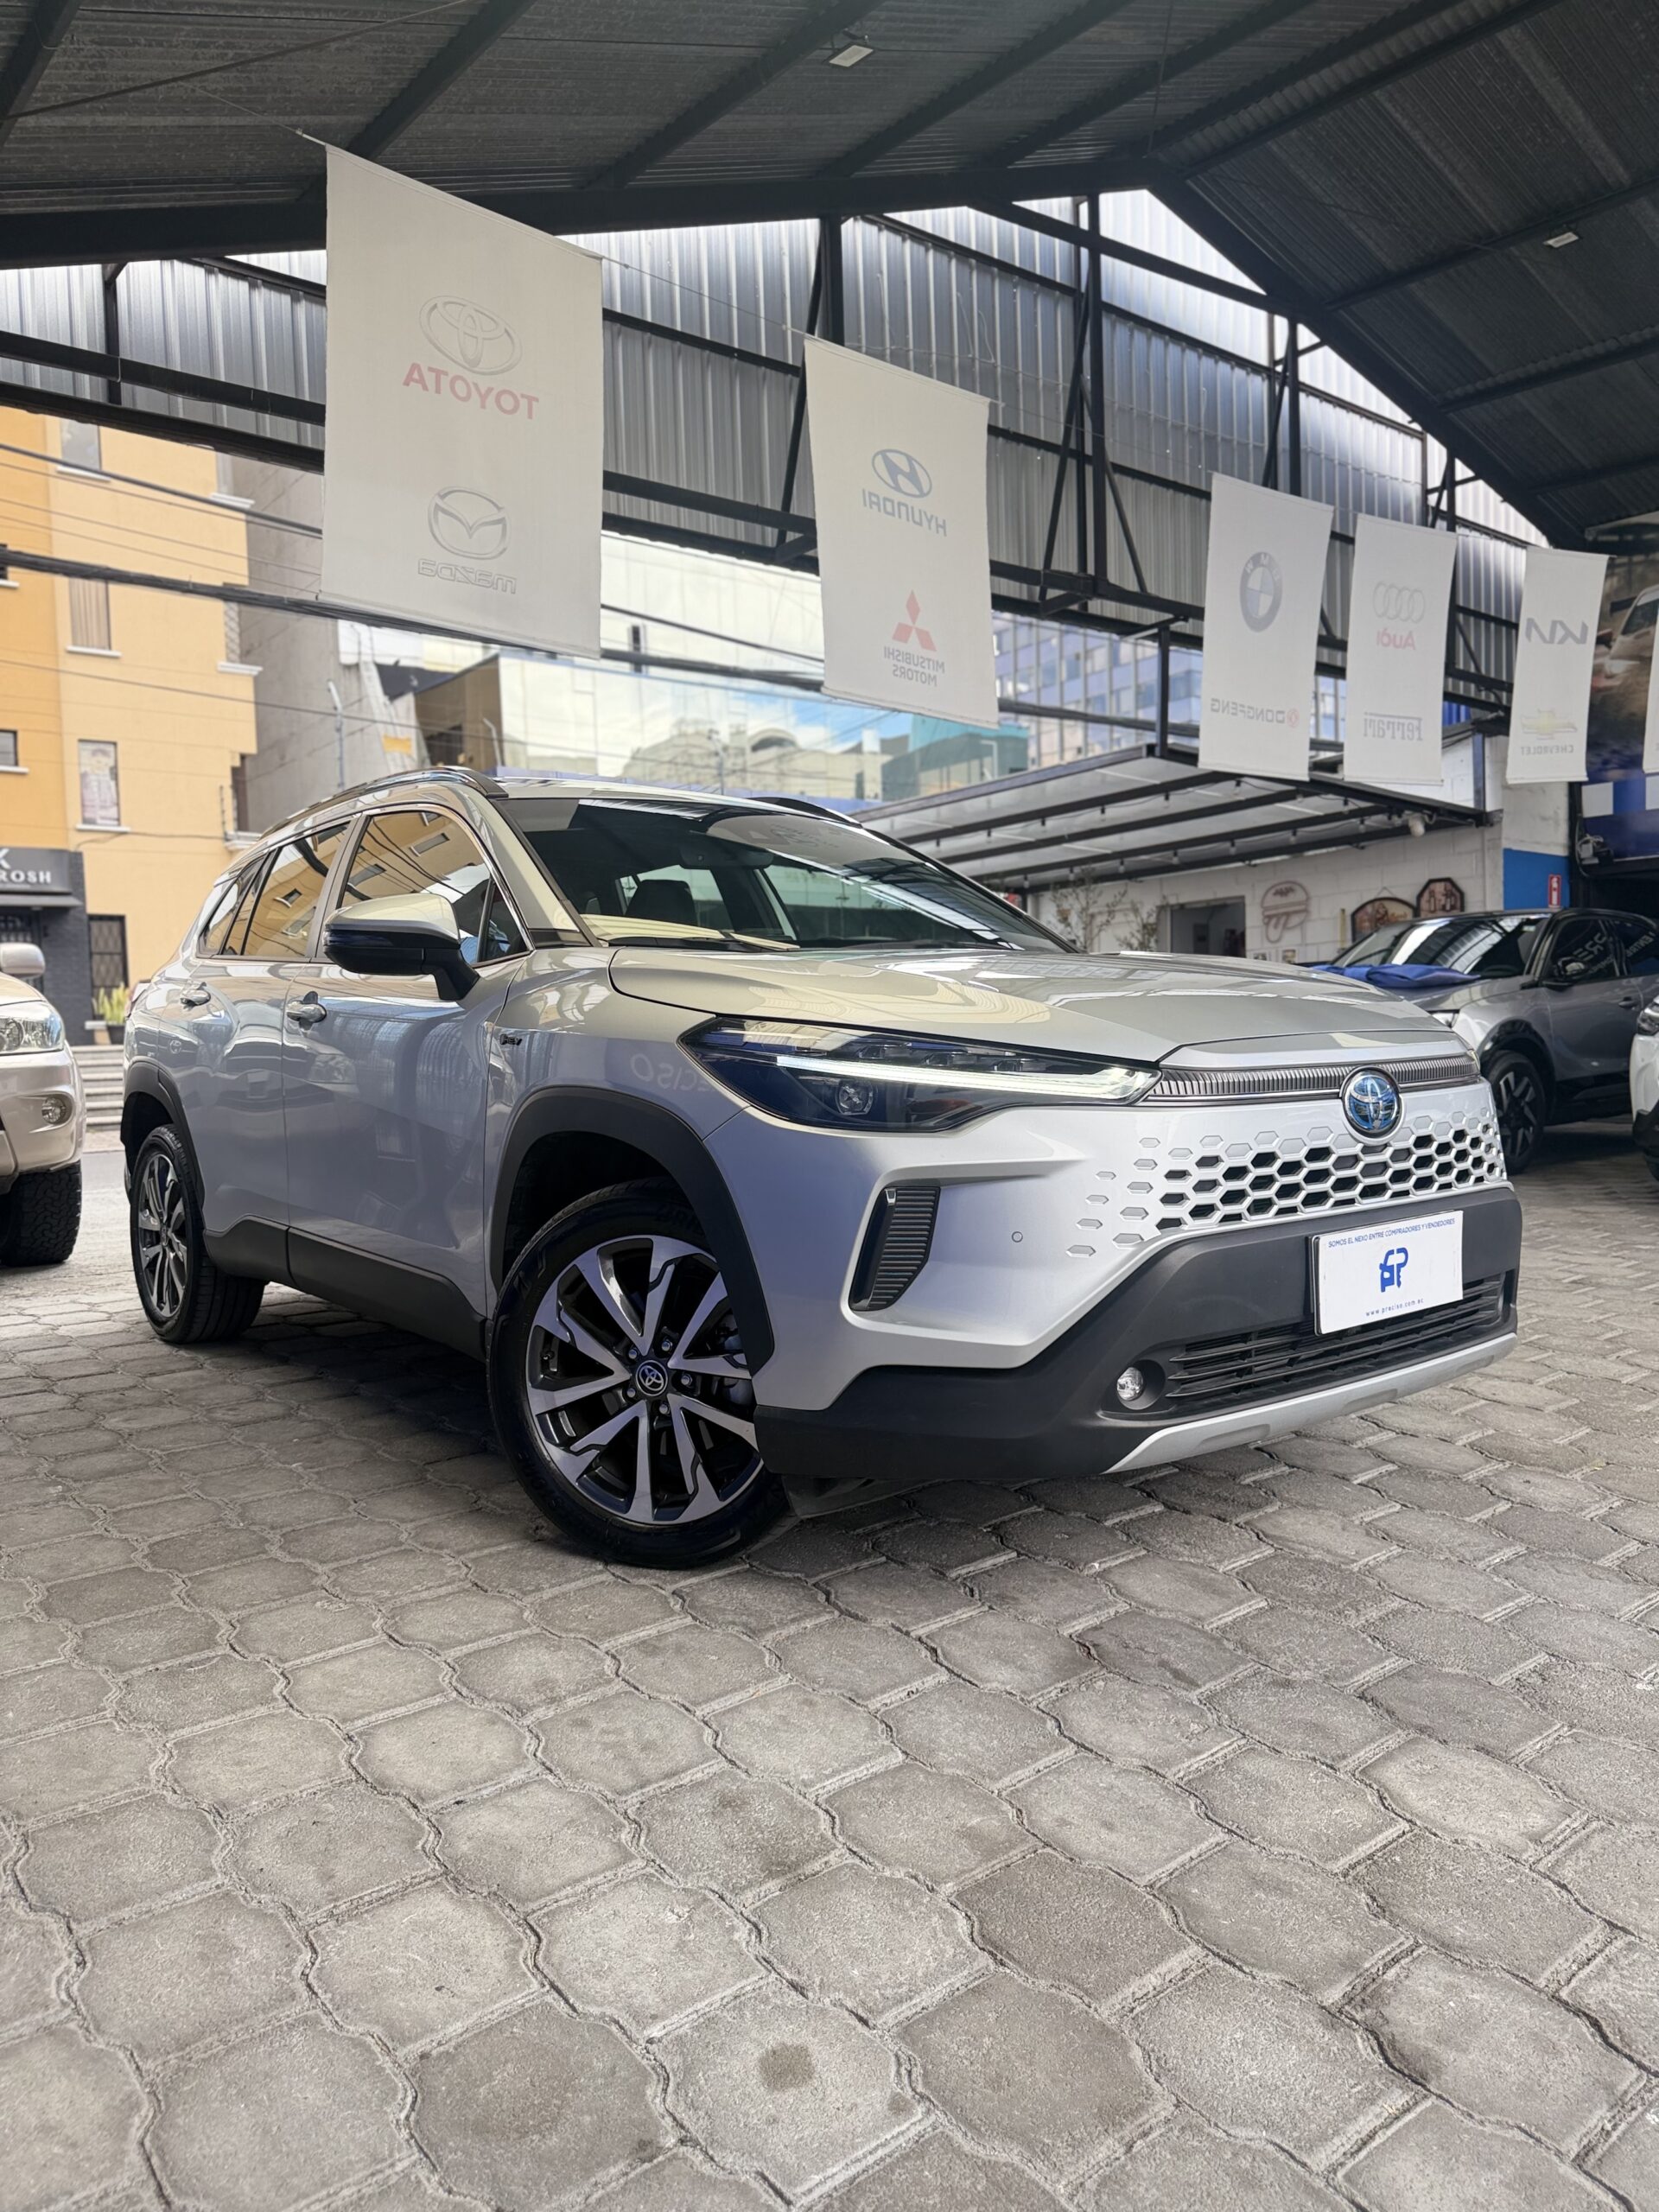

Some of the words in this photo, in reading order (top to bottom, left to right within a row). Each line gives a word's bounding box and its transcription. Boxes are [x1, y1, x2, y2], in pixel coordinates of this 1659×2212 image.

[1328, 1238, 1347, 1248] SOMOS
[1354, 1234, 1368, 1243] NEXO
[1369, 1231, 1384, 1240] ENTRE
[1384, 1225, 1421, 1236] COMPRADORES
[1425, 1218, 1455, 1229] VENDEDORES
